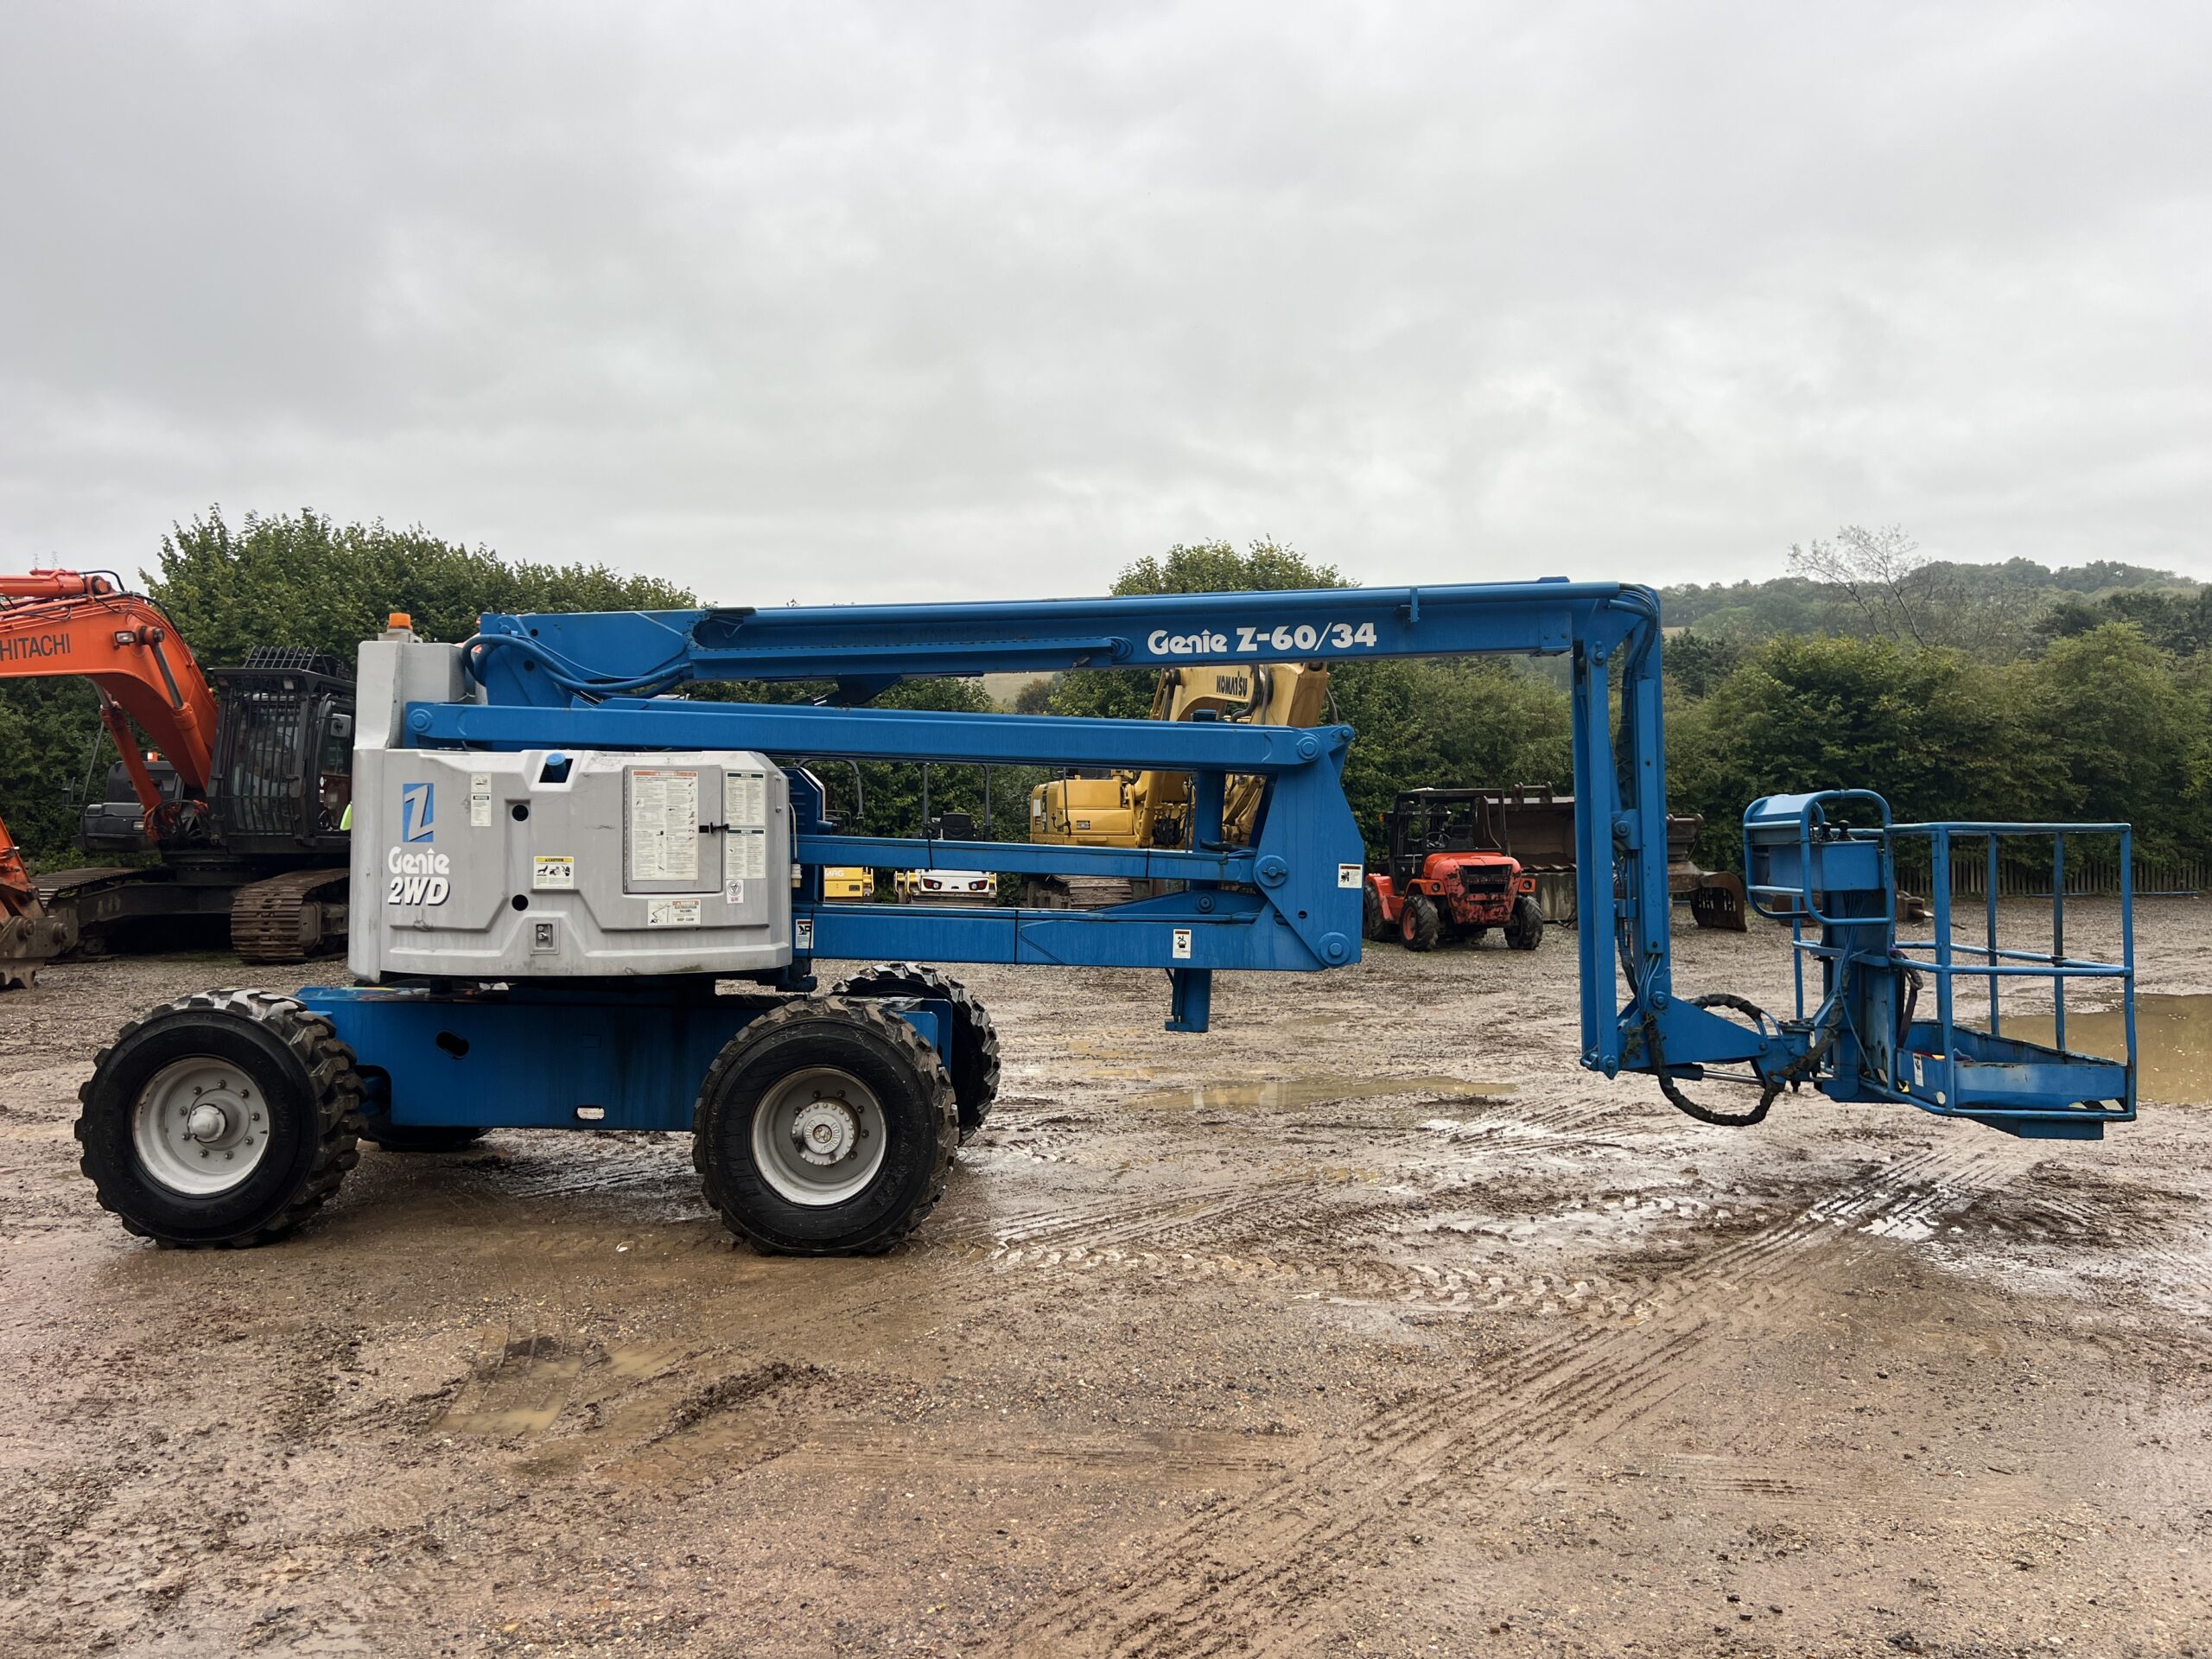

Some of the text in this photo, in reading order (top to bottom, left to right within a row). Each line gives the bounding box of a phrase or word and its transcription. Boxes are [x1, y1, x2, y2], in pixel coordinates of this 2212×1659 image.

[0, 632, 71, 662] HITACHI
[1147, 622, 1377, 655] Genie Z-60/34
[1216, 671, 1248, 697] KOMATSU
[388, 846, 450, 874] Genie
[387, 876, 451, 906] 2WD
